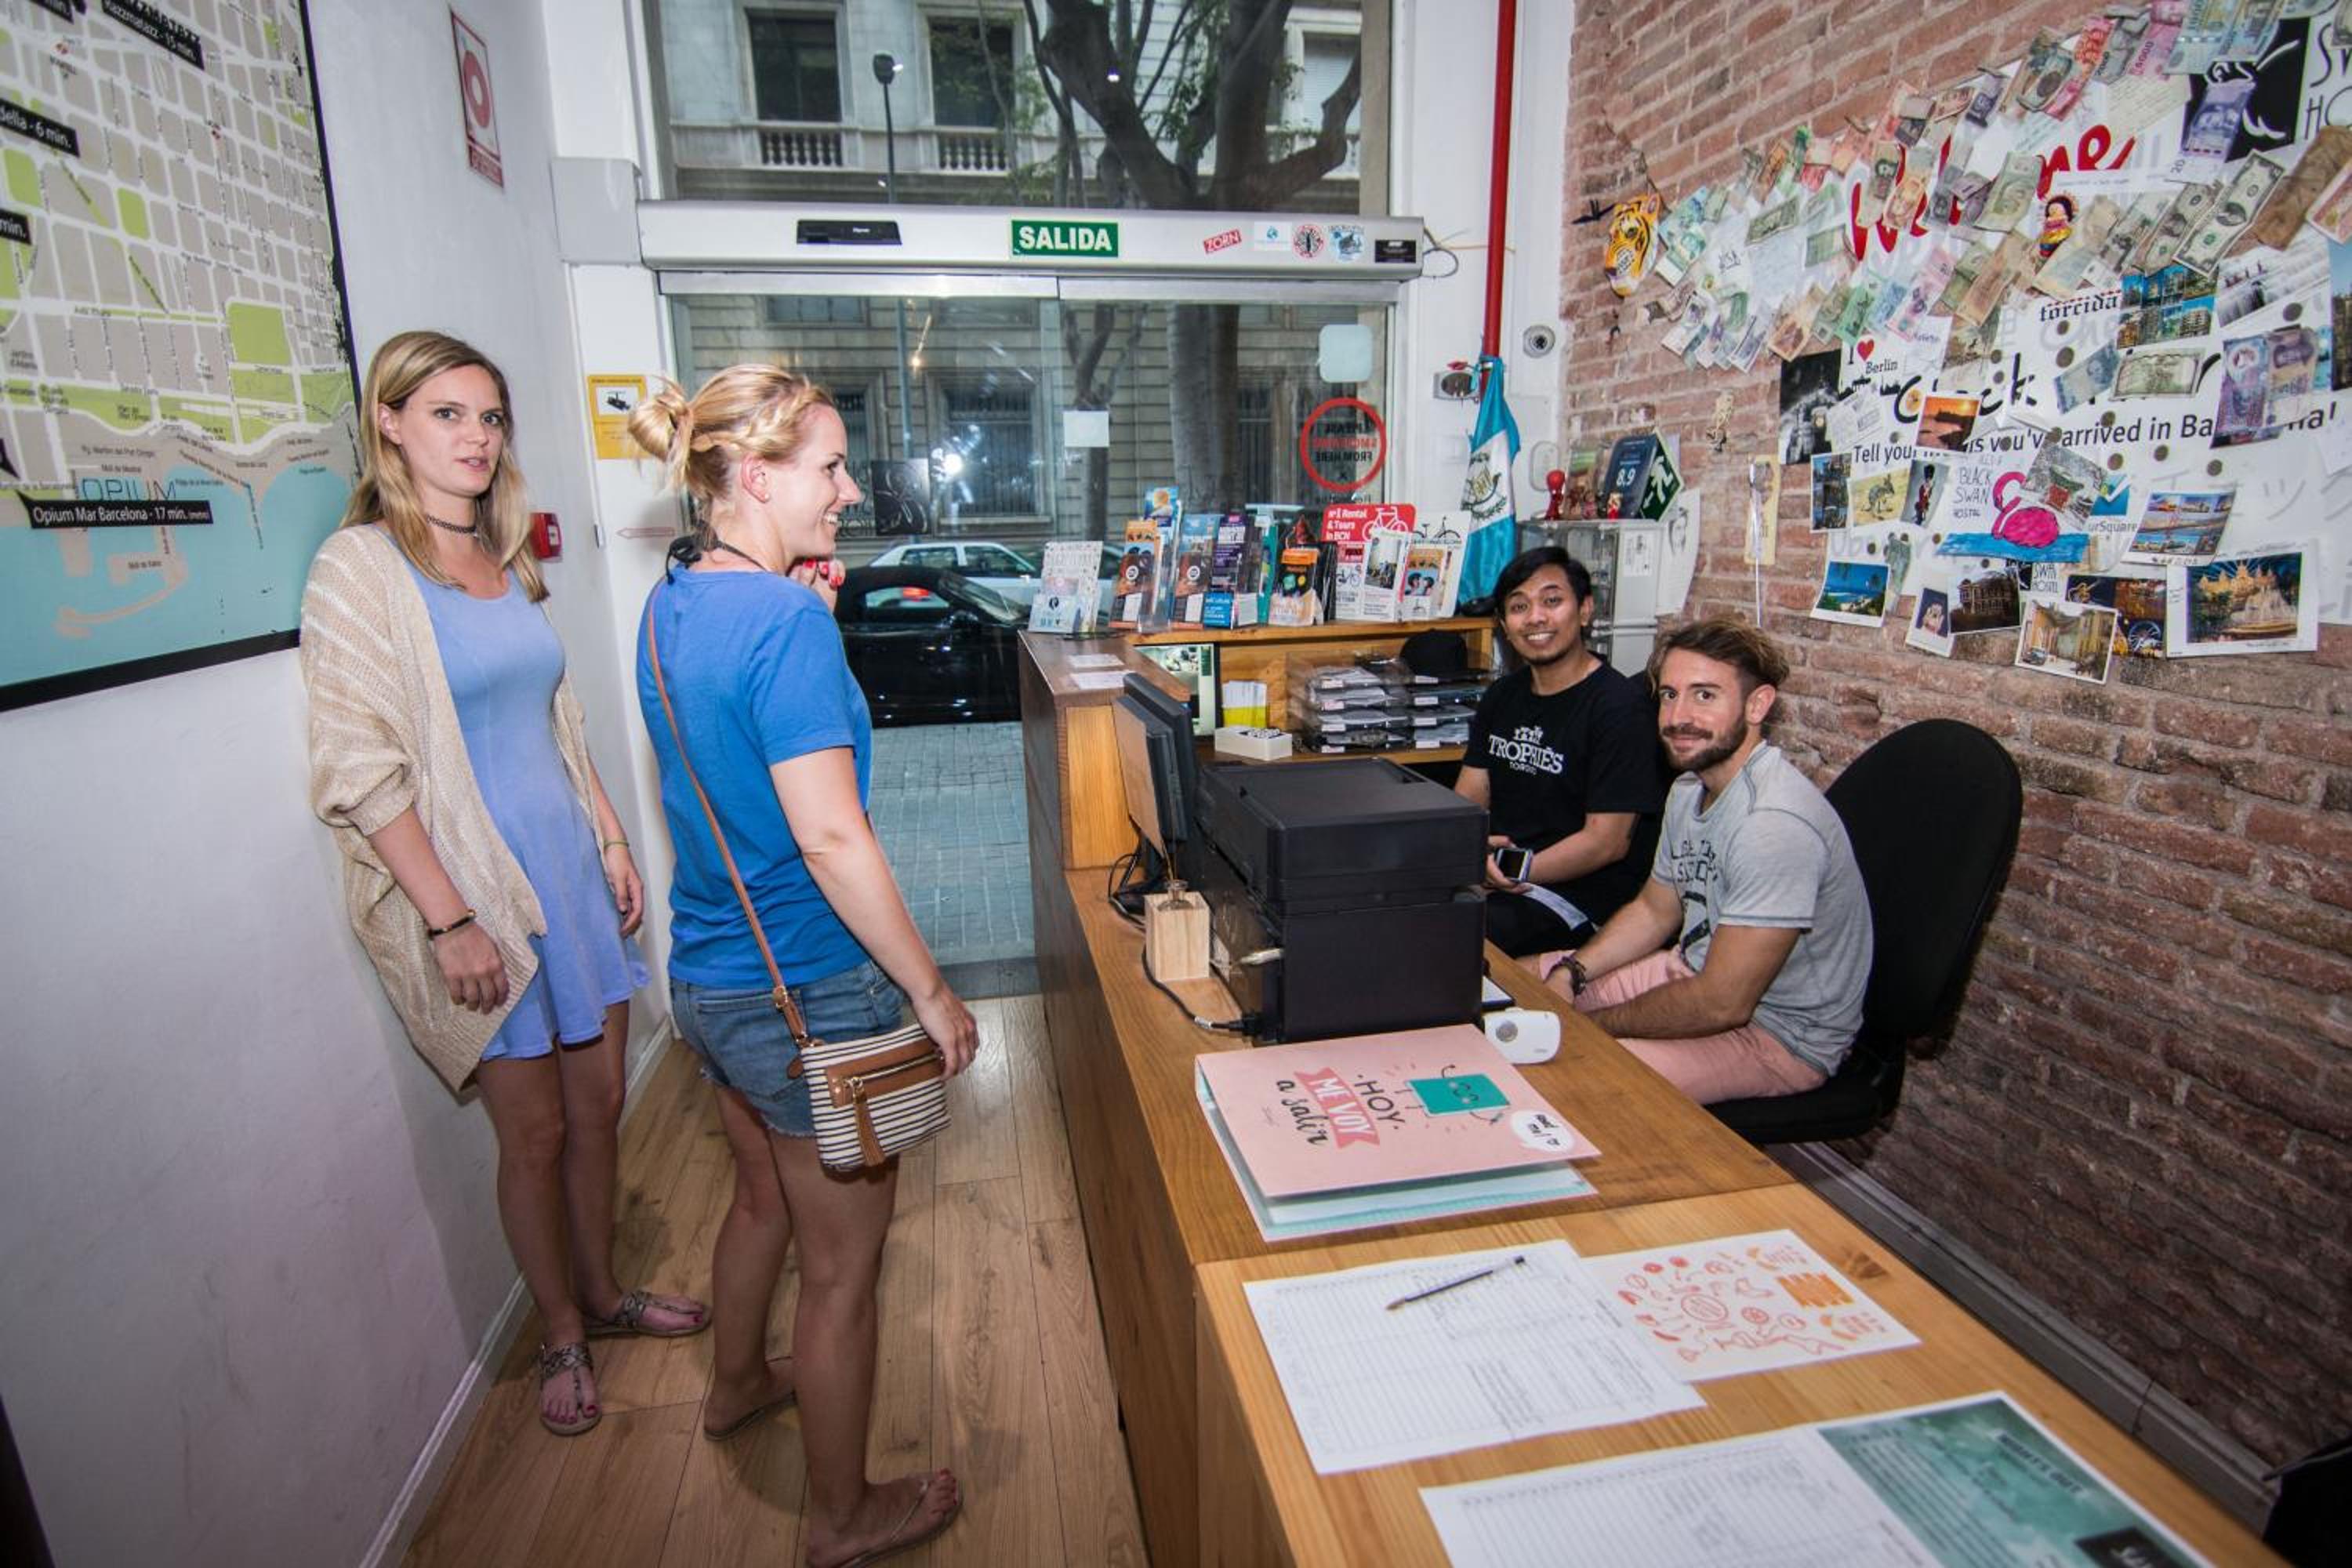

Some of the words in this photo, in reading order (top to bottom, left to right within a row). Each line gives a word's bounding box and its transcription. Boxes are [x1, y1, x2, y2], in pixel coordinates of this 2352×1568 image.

[1019, 226, 1112, 251] SALIDA
[2040, 294, 2119, 321] torcida
[1865, 358, 1898, 374] Berlin
[1853, 444, 1881, 464] Tell
[2061, 423, 2140, 448] arrived
[2149, 419, 2172, 441] in
[80, 477, 177, 501] OPIUM
[33, 506, 74, 525] Opium
[75, 506, 96, 521] Mar
[98, 506, 149, 521] Barcelona
[167, 506, 187, 520] min.
[1354, 1080, 1406, 1123] HOY
[1280, 1098, 1330, 1145] salir
[1329, 1101, 1375, 1134] VOY
